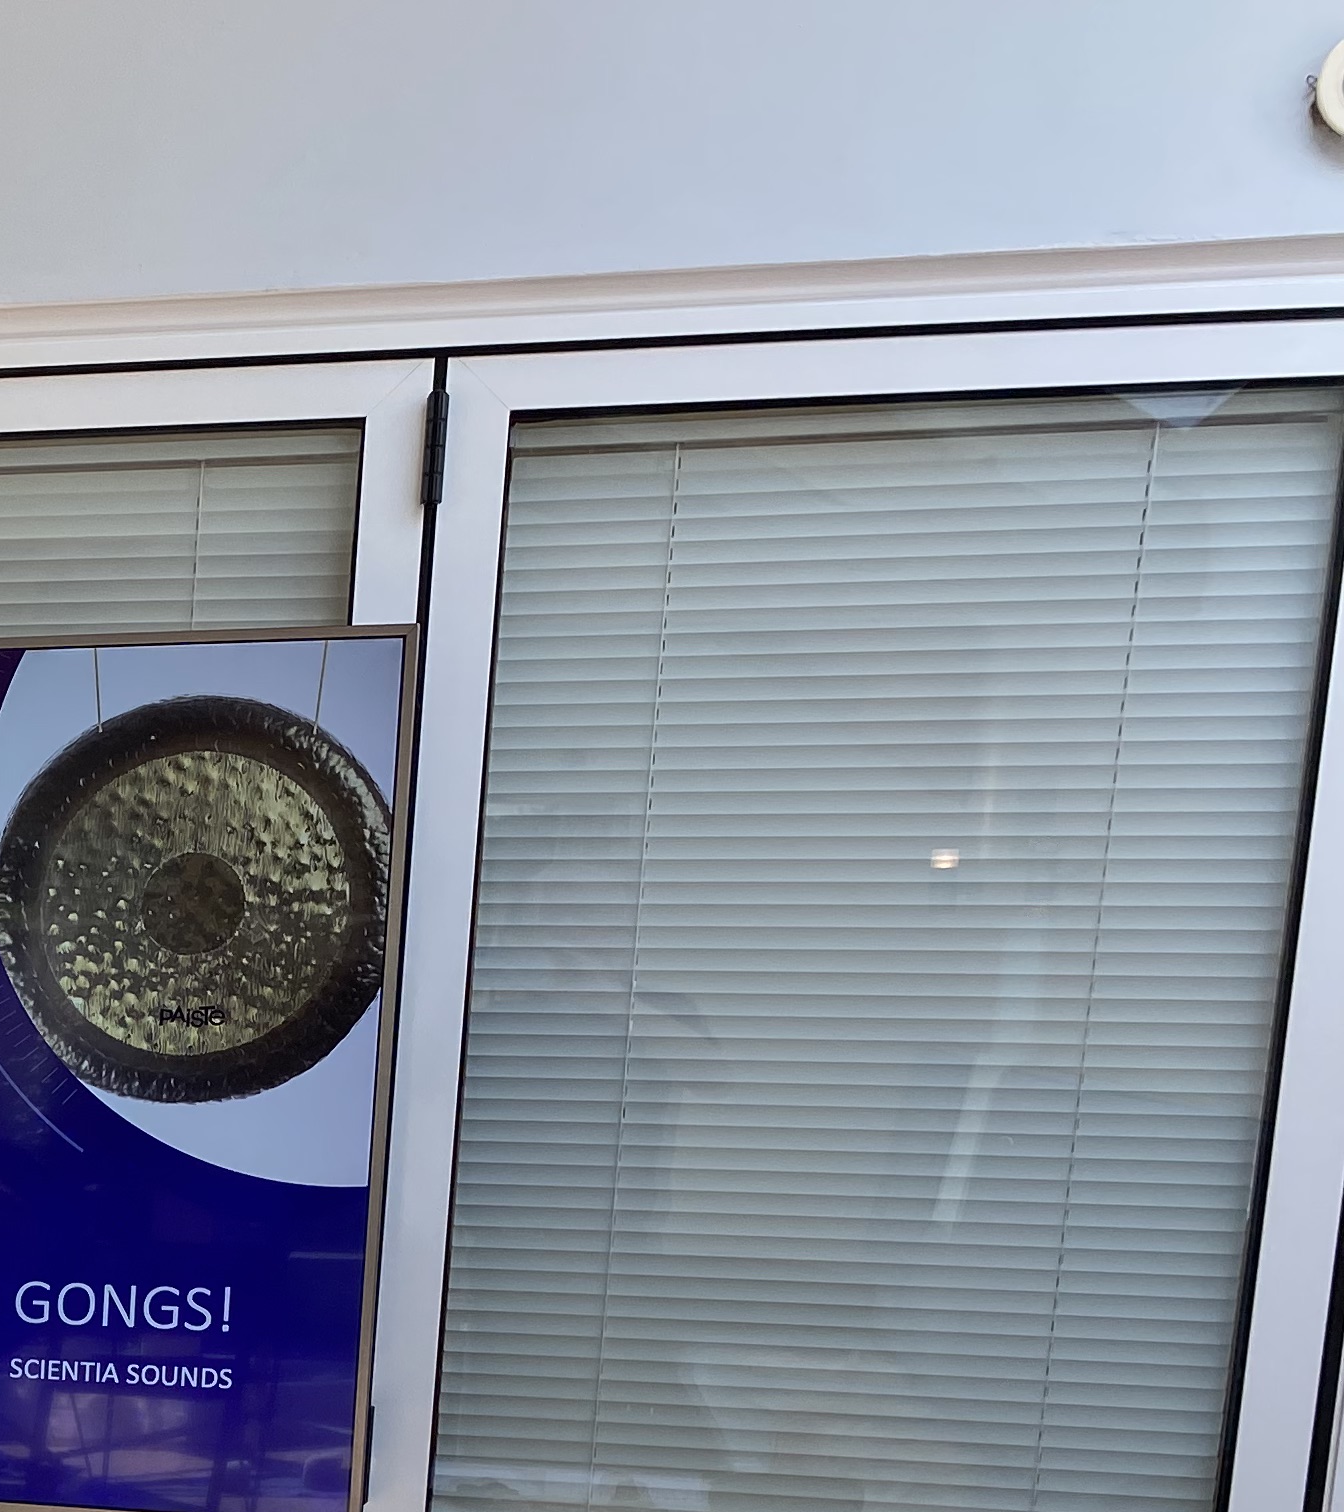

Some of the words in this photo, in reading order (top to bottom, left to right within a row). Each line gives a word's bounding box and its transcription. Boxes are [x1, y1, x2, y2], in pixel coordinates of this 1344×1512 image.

[15, 1281, 231, 1333] GONGS!
[9, 1357, 120, 1384] SCIENTIA
[126, 1363, 233, 1390] SOUNDS
